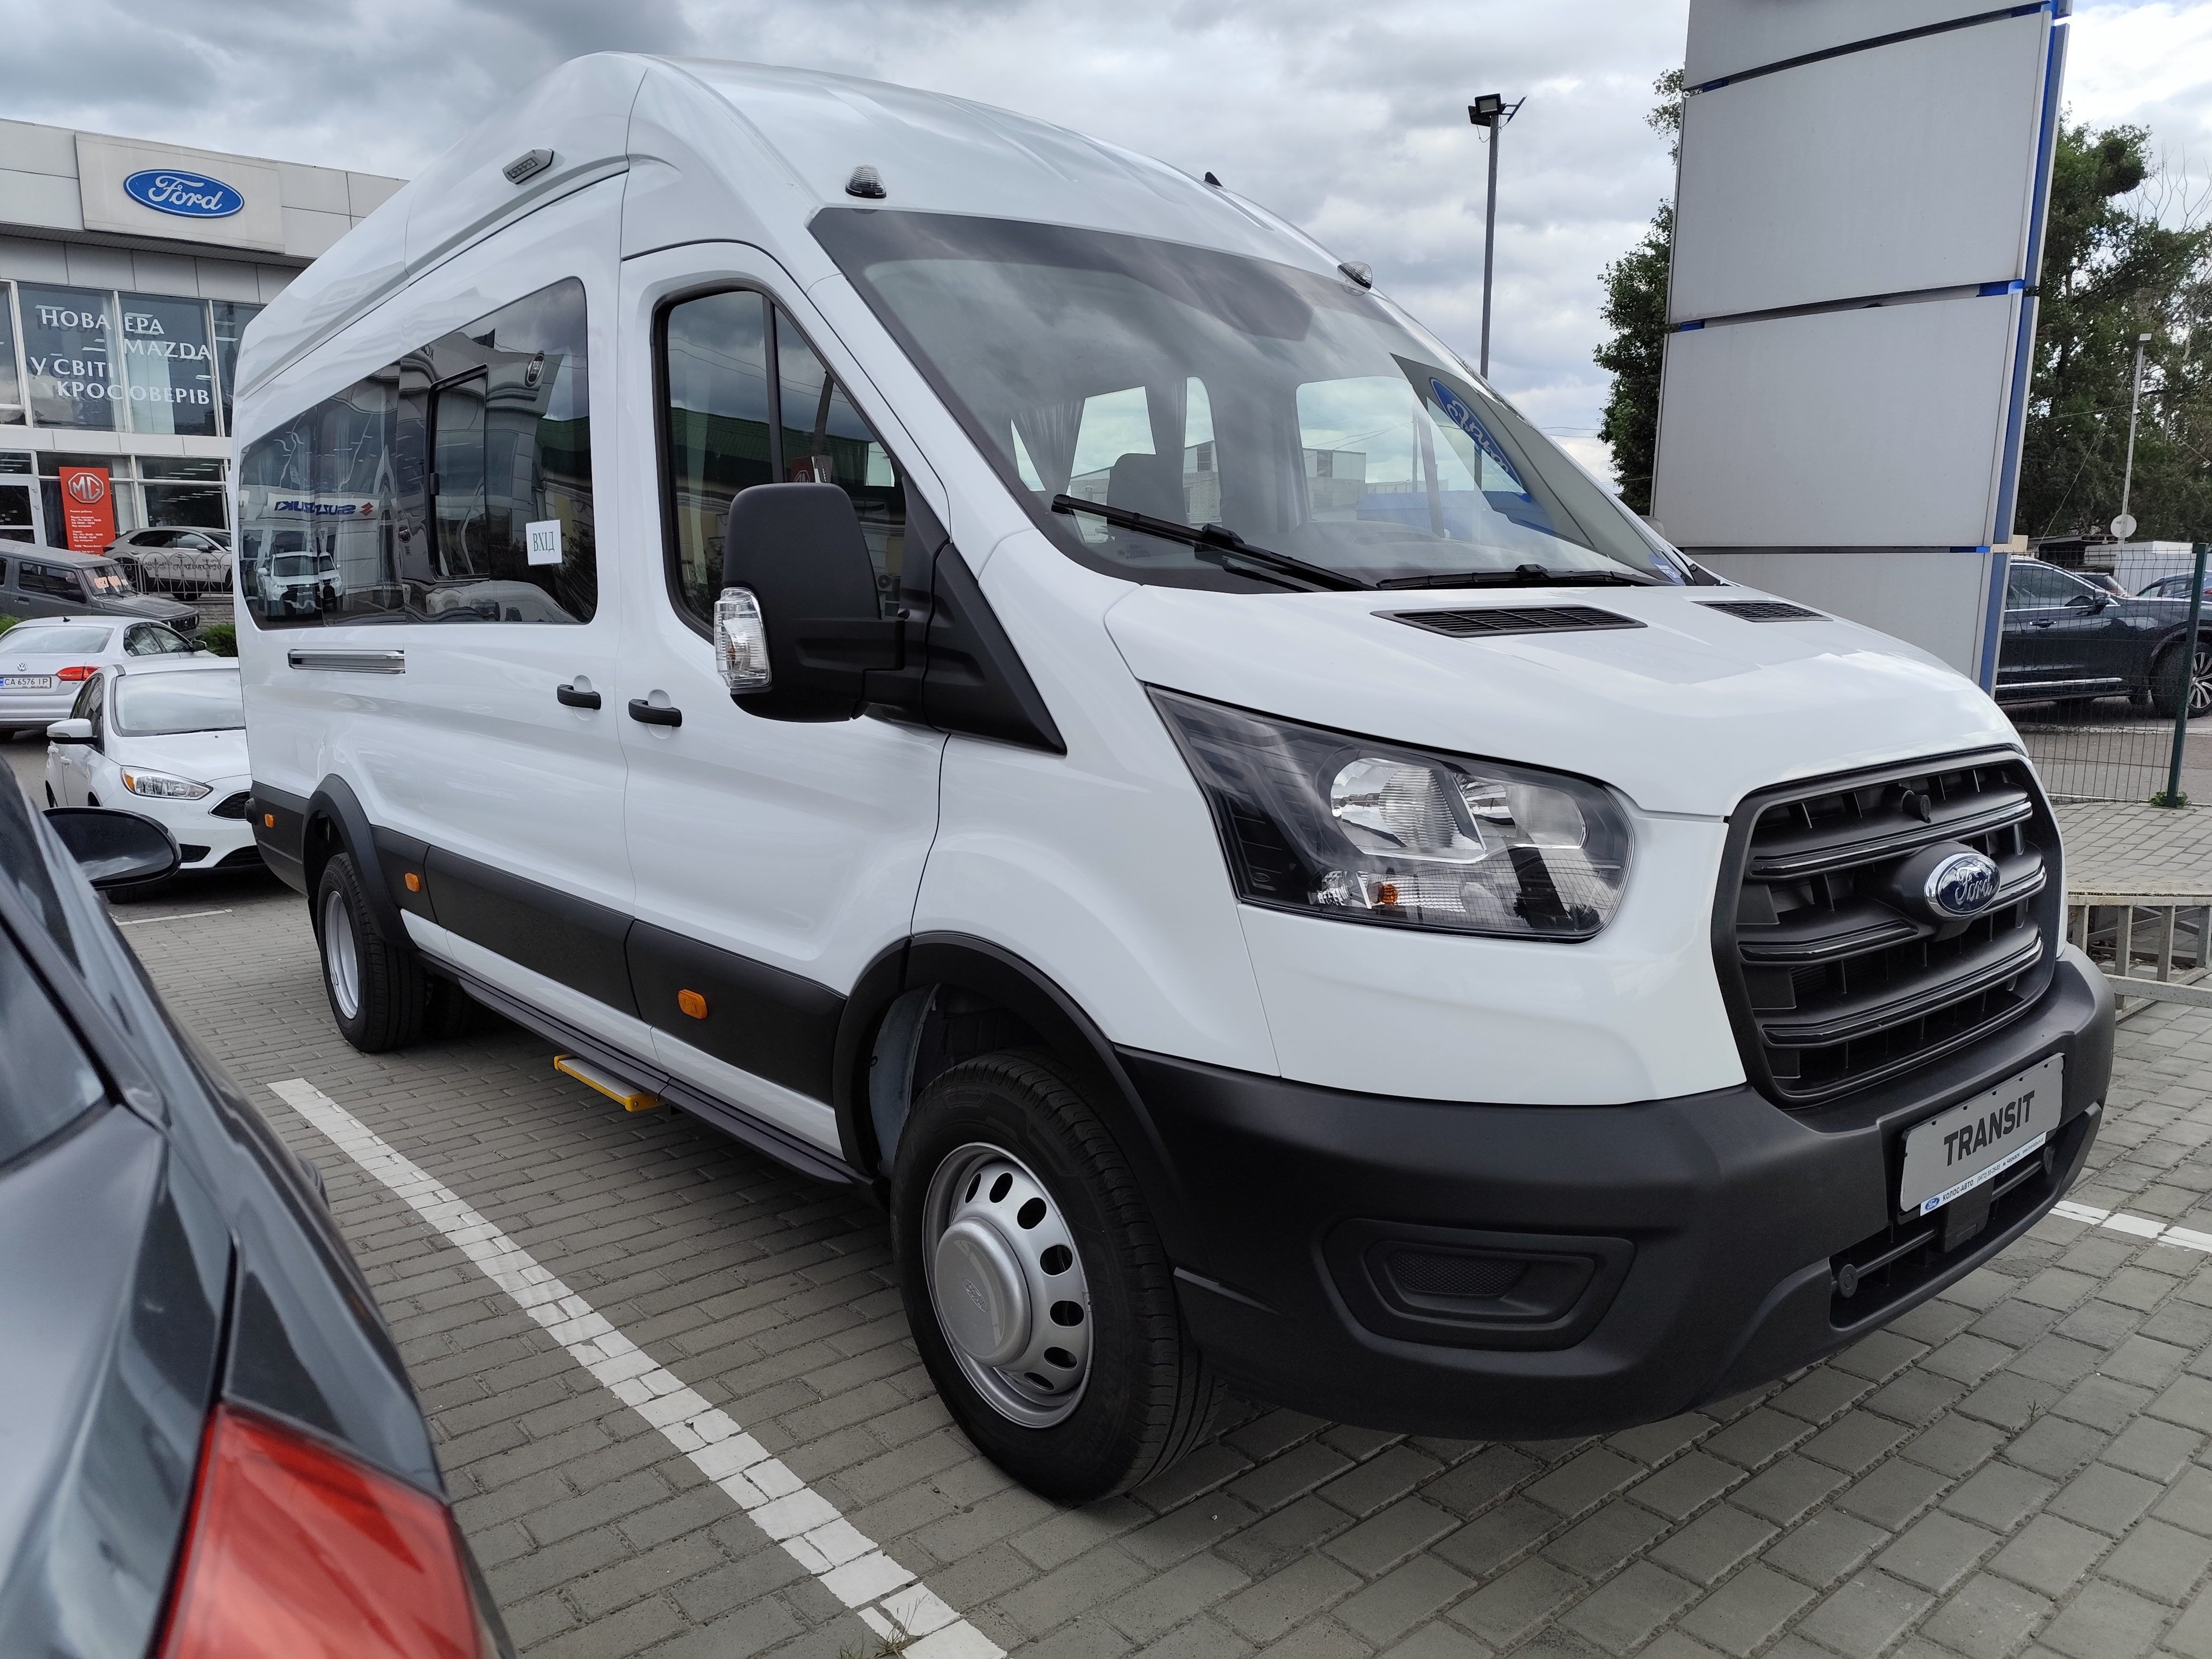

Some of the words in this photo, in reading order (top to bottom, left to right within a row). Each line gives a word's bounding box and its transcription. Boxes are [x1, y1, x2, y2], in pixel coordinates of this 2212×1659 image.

[148, 175, 223, 211] Ford
[41, 308, 111, 330] НОВА
[124, 316, 165, 335] ЕРА
[124, 338, 212, 361] MAZDA
[30, 356, 47, 376] У
[54, 358, 114, 378] СВІТІ
[57, 381, 210, 405] КРОСОВЕРІВ
[72, 475, 101, 500] MG
[532, 531, 555, 555] ВХІД
[1954, 863, 1993, 905] Ford
[1944, 1089, 2035, 1166] TRANSIT
[1926, 1198, 1938, 1210] Ford
[1942, 1179, 1974, 1201] КОЛОС-АВТО
